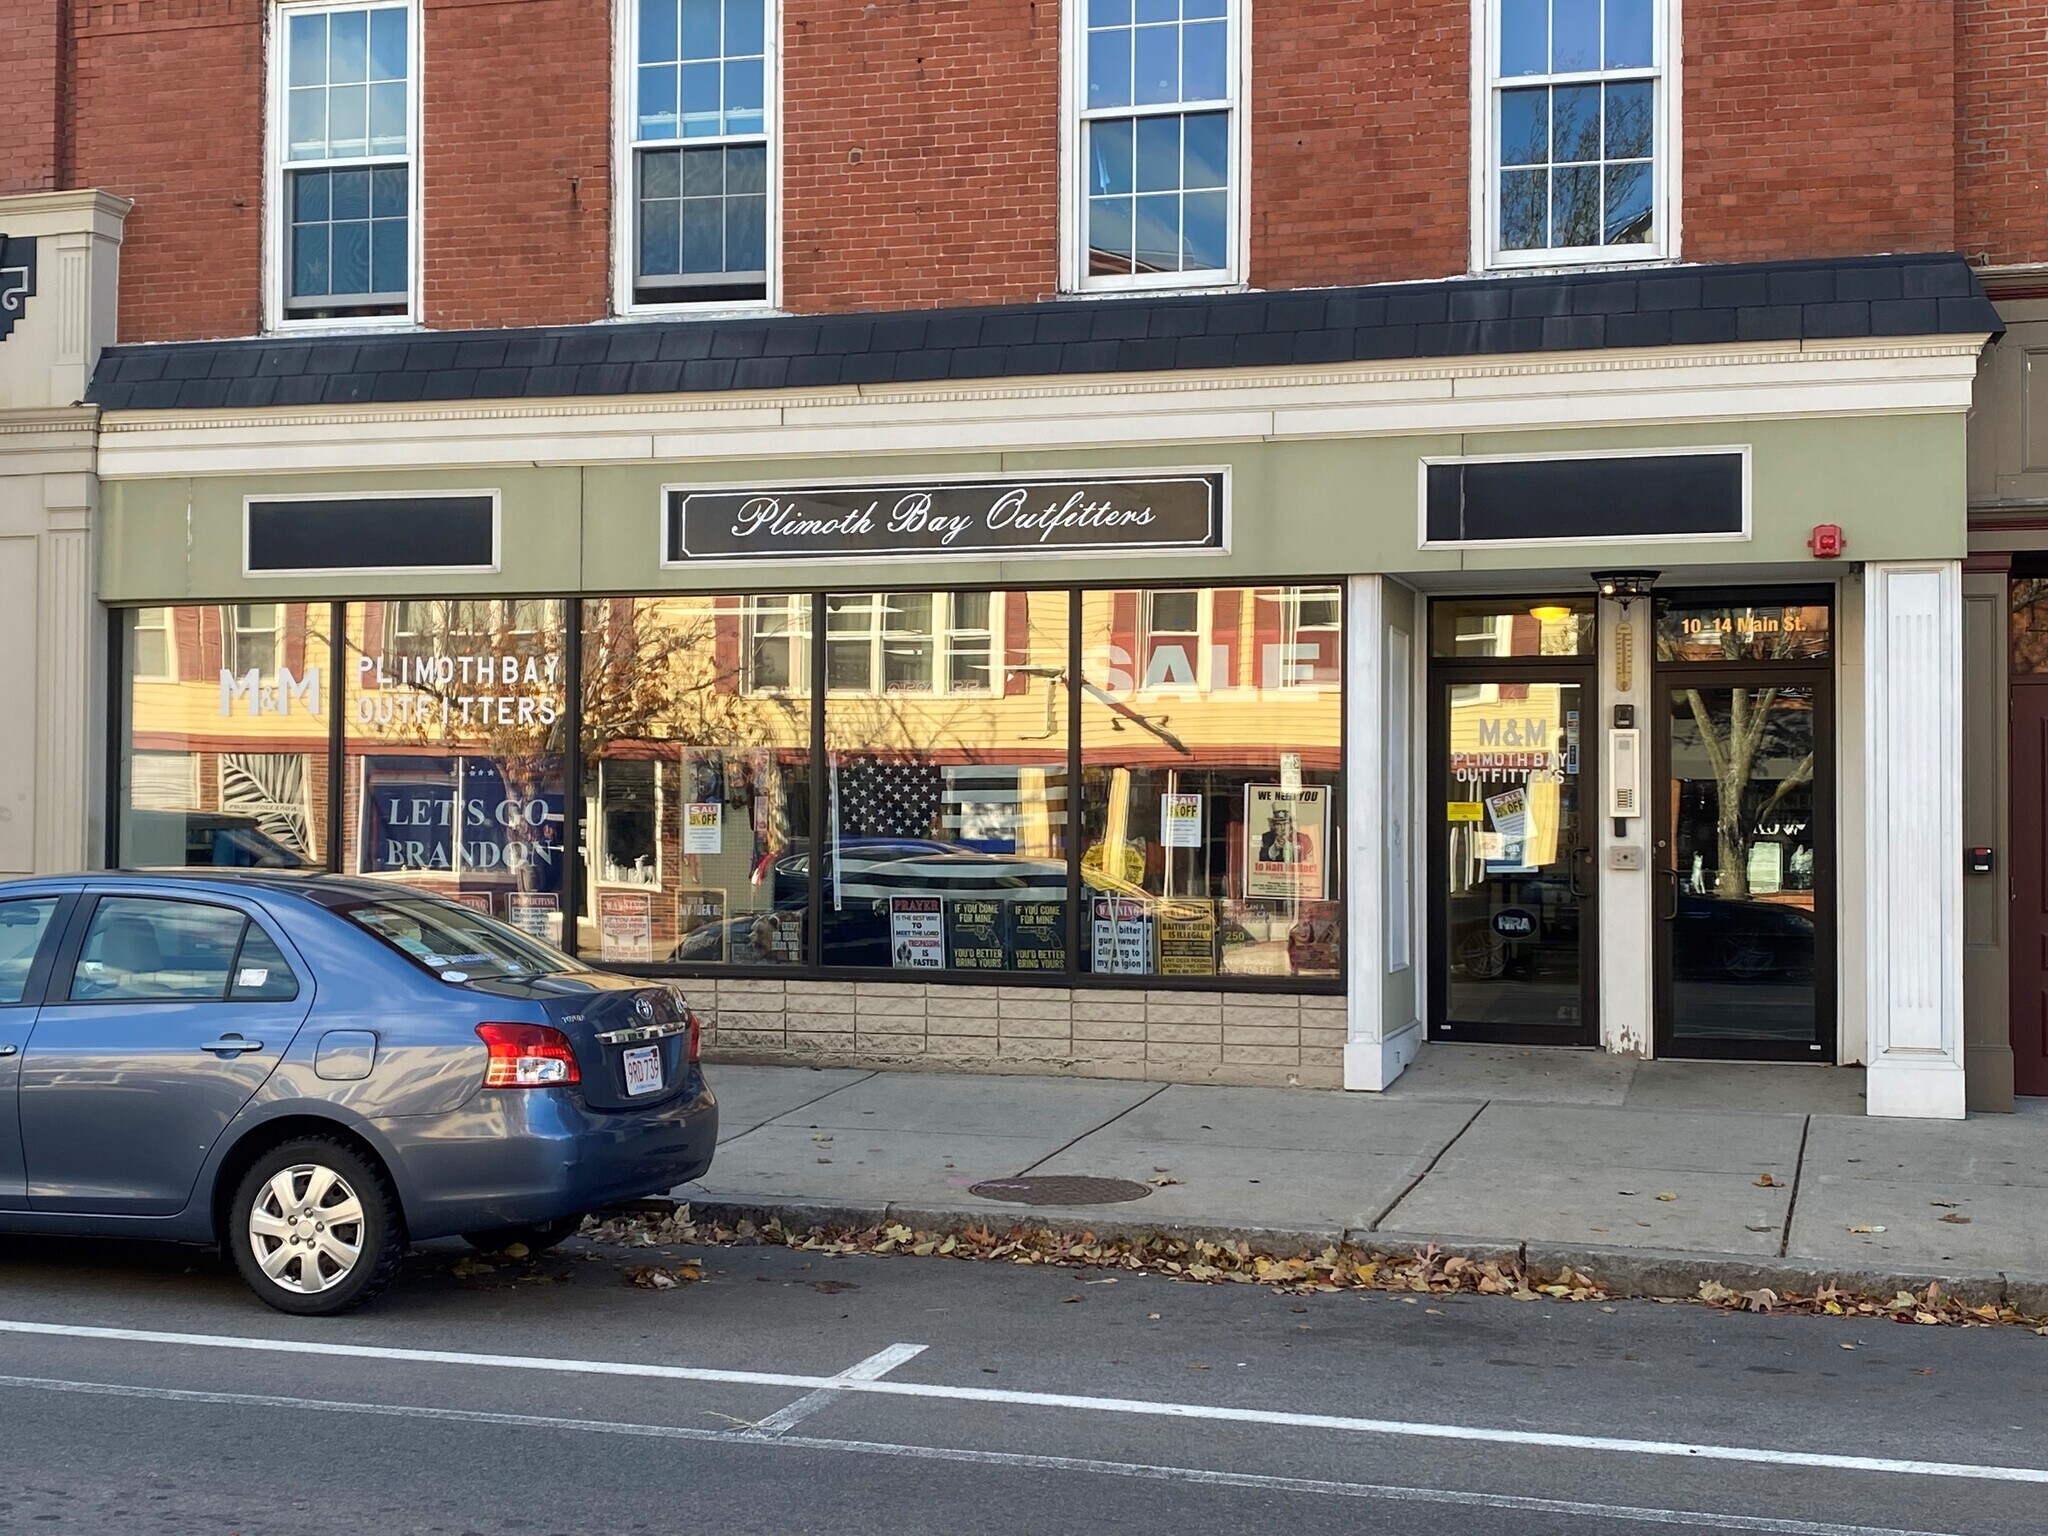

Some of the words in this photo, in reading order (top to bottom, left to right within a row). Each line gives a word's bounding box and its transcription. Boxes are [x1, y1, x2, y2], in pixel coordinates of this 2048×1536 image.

[731, 496, 876, 538] Plimoth
[887, 492, 974, 544] Bay
[985, 487, 1157, 542] Outfitters
[1737, 616, 1778, 632] Main
[1783, 616, 1806, 632] St.
[1100, 643, 1320, 703] SALE
[219, 667, 321, 717] M&M
[357, 695, 557, 726] OUTFITTERS
[1479, 718, 1547, 747] M&M
[1453, 752, 1528, 767] PLIMOTH
[1456, 768, 1565, 784] OUTFITTERS
[1257, 791, 1271, 801] WE
[1299, 791, 1319, 802] YOU
[1492, 791, 1521, 807] SALE
[1180, 805, 1197, 817] OFF
[1508, 800, 1524, 814] OFF
[388, 798, 484, 828] LET'S
[495, 798, 549, 828] GO
[702, 814, 717, 825] OFF
[387, 840, 554, 869] BRANDON
[894, 900, 940, 911] PRAYER
[954, 904, 961, 913] IF
[963, 903, 978, 913] YOU
[979, 904, 999, 914] COME
[1015, 906, 1022, 915] IF
[1024, 906, 1038, 915] YOU
[1040, 906, 1060, 916] COME
[959, 914, 973, 923] FOR
[1020, 915, 1034, 924] FOR
[1498, 915, 1531, 931] NRA
[1119, 924, 1141, 934] bitter
[1162, 923, 1191, 931] BAITING
[1192, 923, 1211, 931] DEER
[1168, 931, 1176, 939] IS
[1225, 931, 1245, 941] 250
[954, 948, 975, 958] YOU'D
[976, 948, 1002, 958] BETTER
[1015, 950, 1036, 959] YOU'D
[1038, 950, 1065, 959] BETTER
[1098, 947, 1129, 958] clingng
[1132, 948, 1140, 956] to
[956, 958, 977, 967] BRING
[978, 958, 1002, 968] YOURS
[1017, 959, 1039, 968] BRING
[1041, 959, 1064, 969] YOURS
[1097, 960, 1108, 969] my
[1111, 959, 1141, 969] reigion
